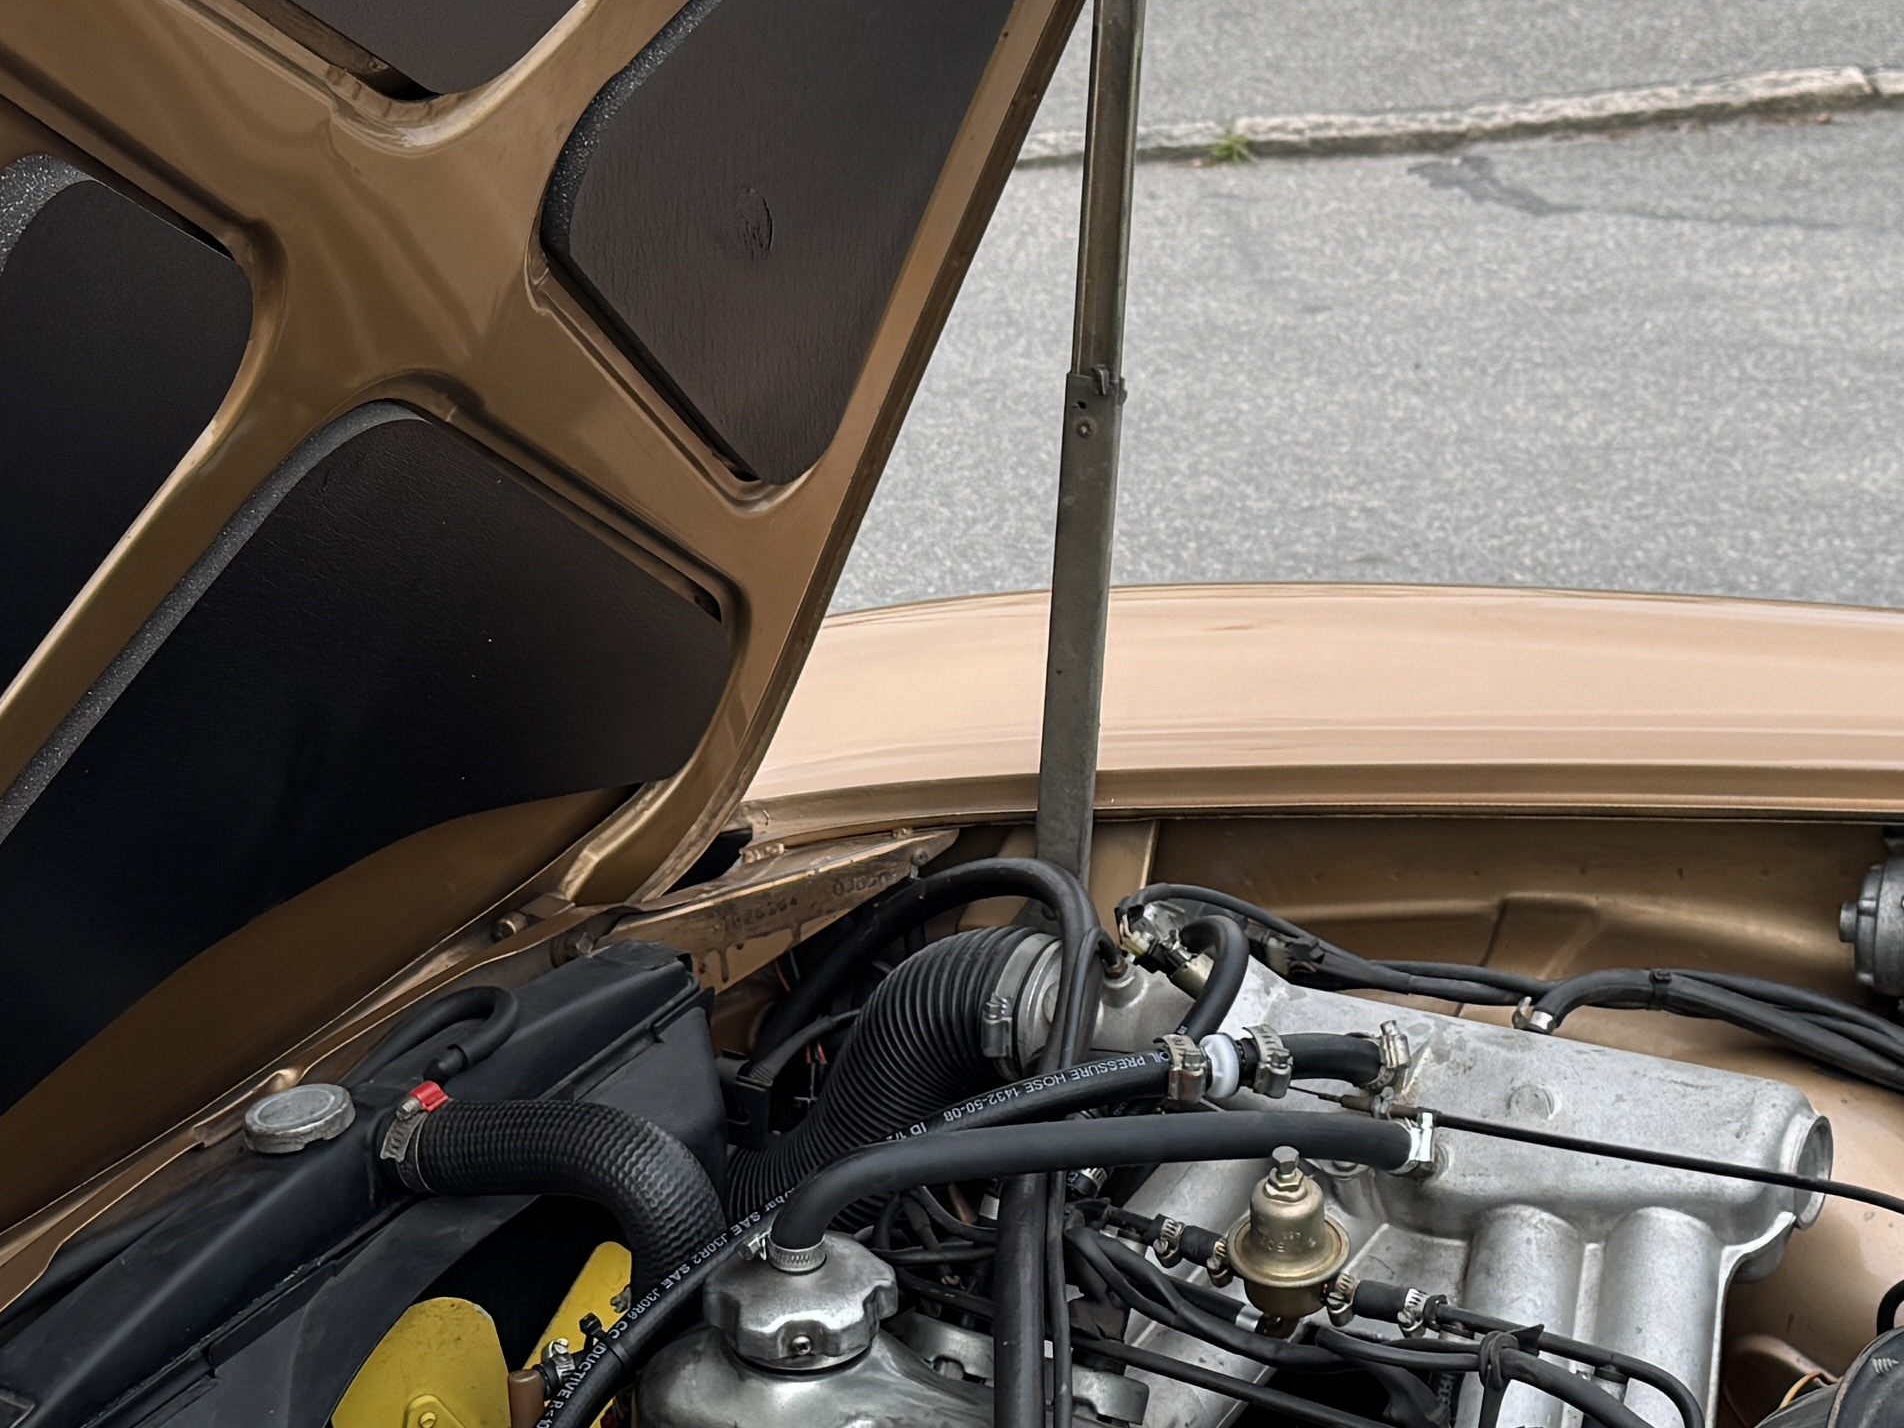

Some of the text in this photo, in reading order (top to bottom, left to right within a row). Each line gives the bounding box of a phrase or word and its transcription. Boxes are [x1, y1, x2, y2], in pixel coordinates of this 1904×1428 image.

[1071, 1055, 1146, 1082] PRESSURE
[1025, 1072, 1067, 1094] HOSE
[942, 1087, 1020, 1123] 1432-50-08
[909, 1121, 927, 1137] ID
[730, 1211, 761, 1237] SAE
[693, 1232, 728, 1265] J30R2
[660, 1263, 691, 1290] SAE
[557, 1321, 630, 1399] CODUCTIVE
